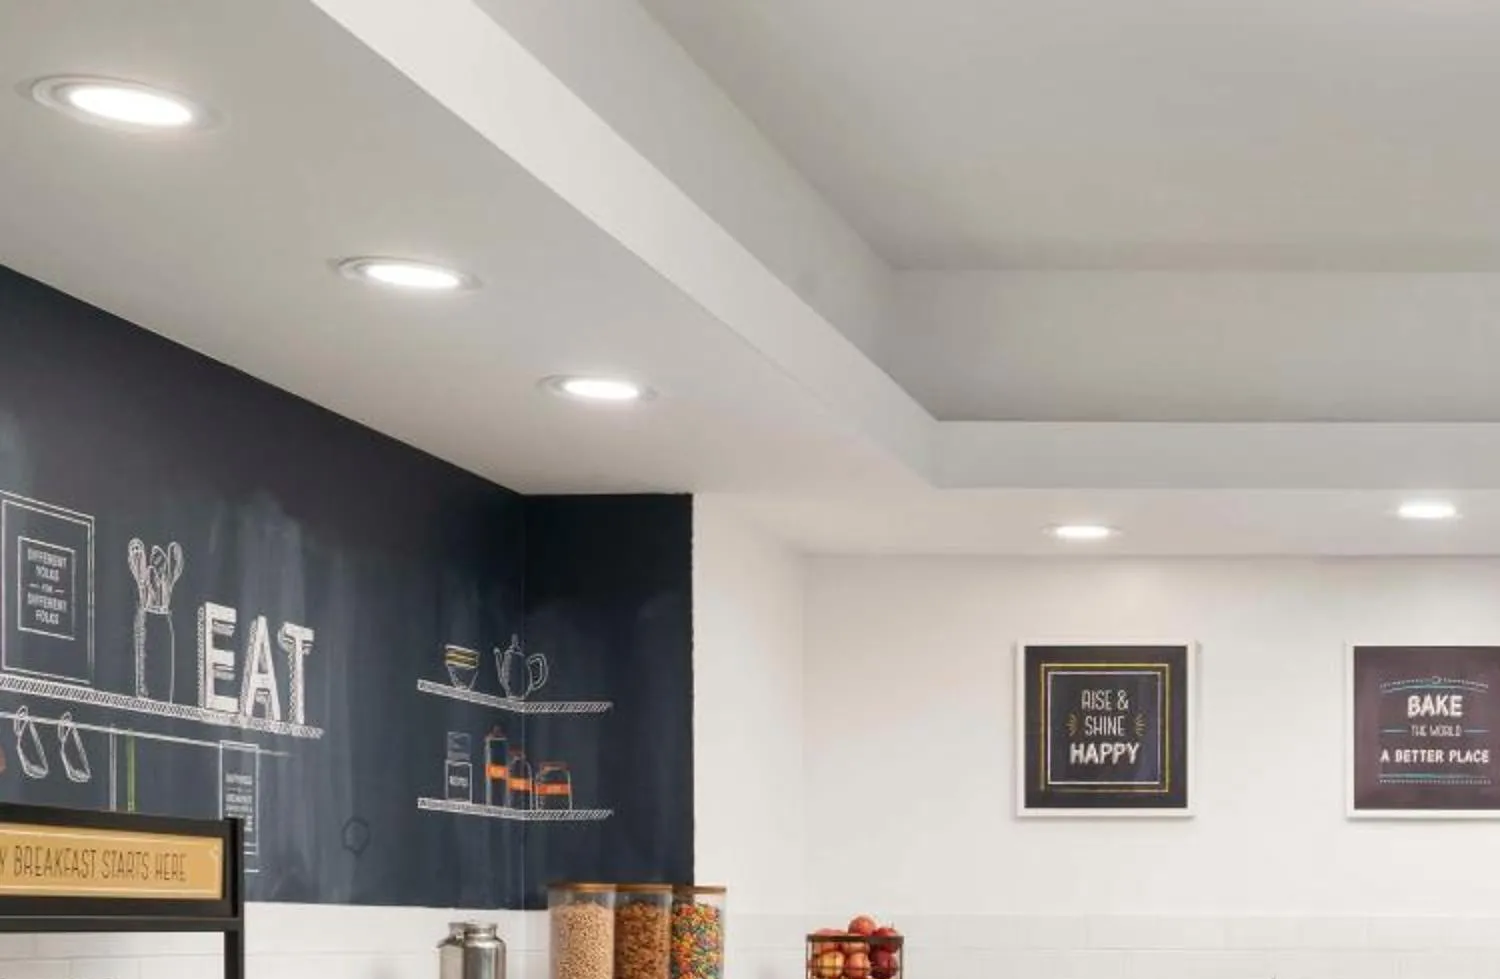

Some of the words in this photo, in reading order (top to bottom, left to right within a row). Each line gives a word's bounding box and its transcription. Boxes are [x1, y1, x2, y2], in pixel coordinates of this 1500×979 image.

[197, 601, 314, 724] EAT
[1081, 689, 1113, 711] RISE
[1117, 689, 1129, 710] &
[1407, 695, 1463, 718] BAKE
[1084, 715, 1125, 737] SHINE
[1411, 725, 1427, 736] THE
[1429, 725, 1461, 737] WORLD
[1069, 742, 1140, 765] HAPPY
[1380, 749, 1390, 762] A
[1395, 749, 1445, 763] BETTER
[1449, 749, 1489, 763] PLACE
[13, 845, 97, 879] BREAKFAST
[101, 850, 149, 881] STARTS
[154, 853, 187, 883] HERE
